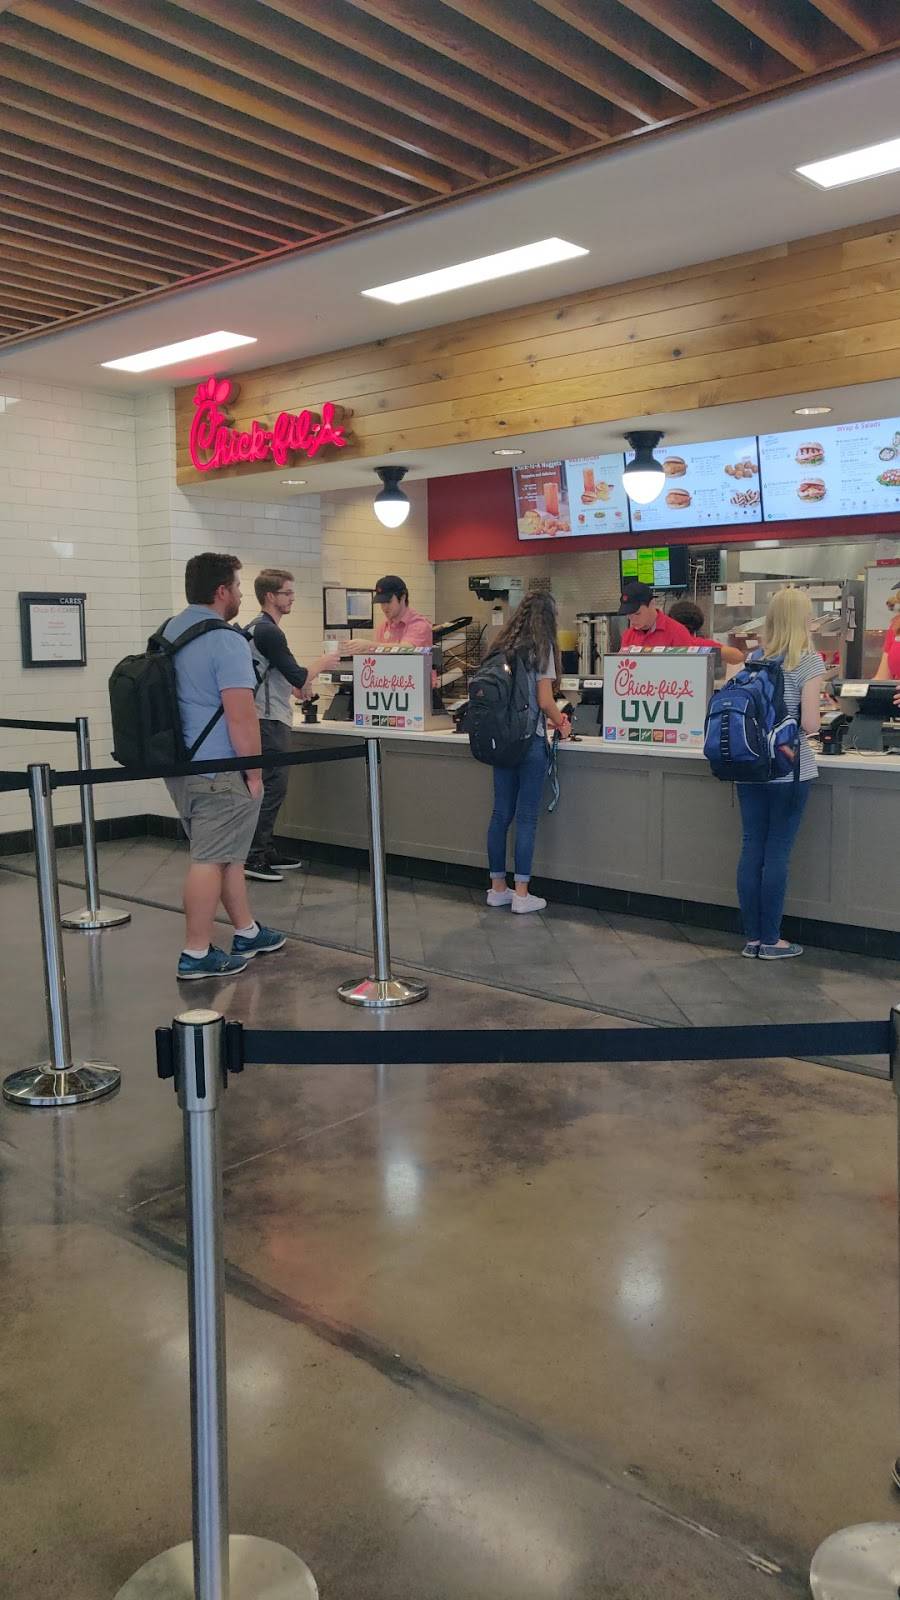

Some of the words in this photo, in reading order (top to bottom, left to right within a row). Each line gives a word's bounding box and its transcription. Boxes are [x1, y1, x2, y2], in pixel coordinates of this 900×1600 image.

[189, 376, 347, 472] Chick-fil-A
[360, 657, 415, 692] Chick-fil-A
[614, 659, 694, 700] Chick-fil-A
[366, 691, 408, 712] UVU
[620, 699, 684, 724] UVU
